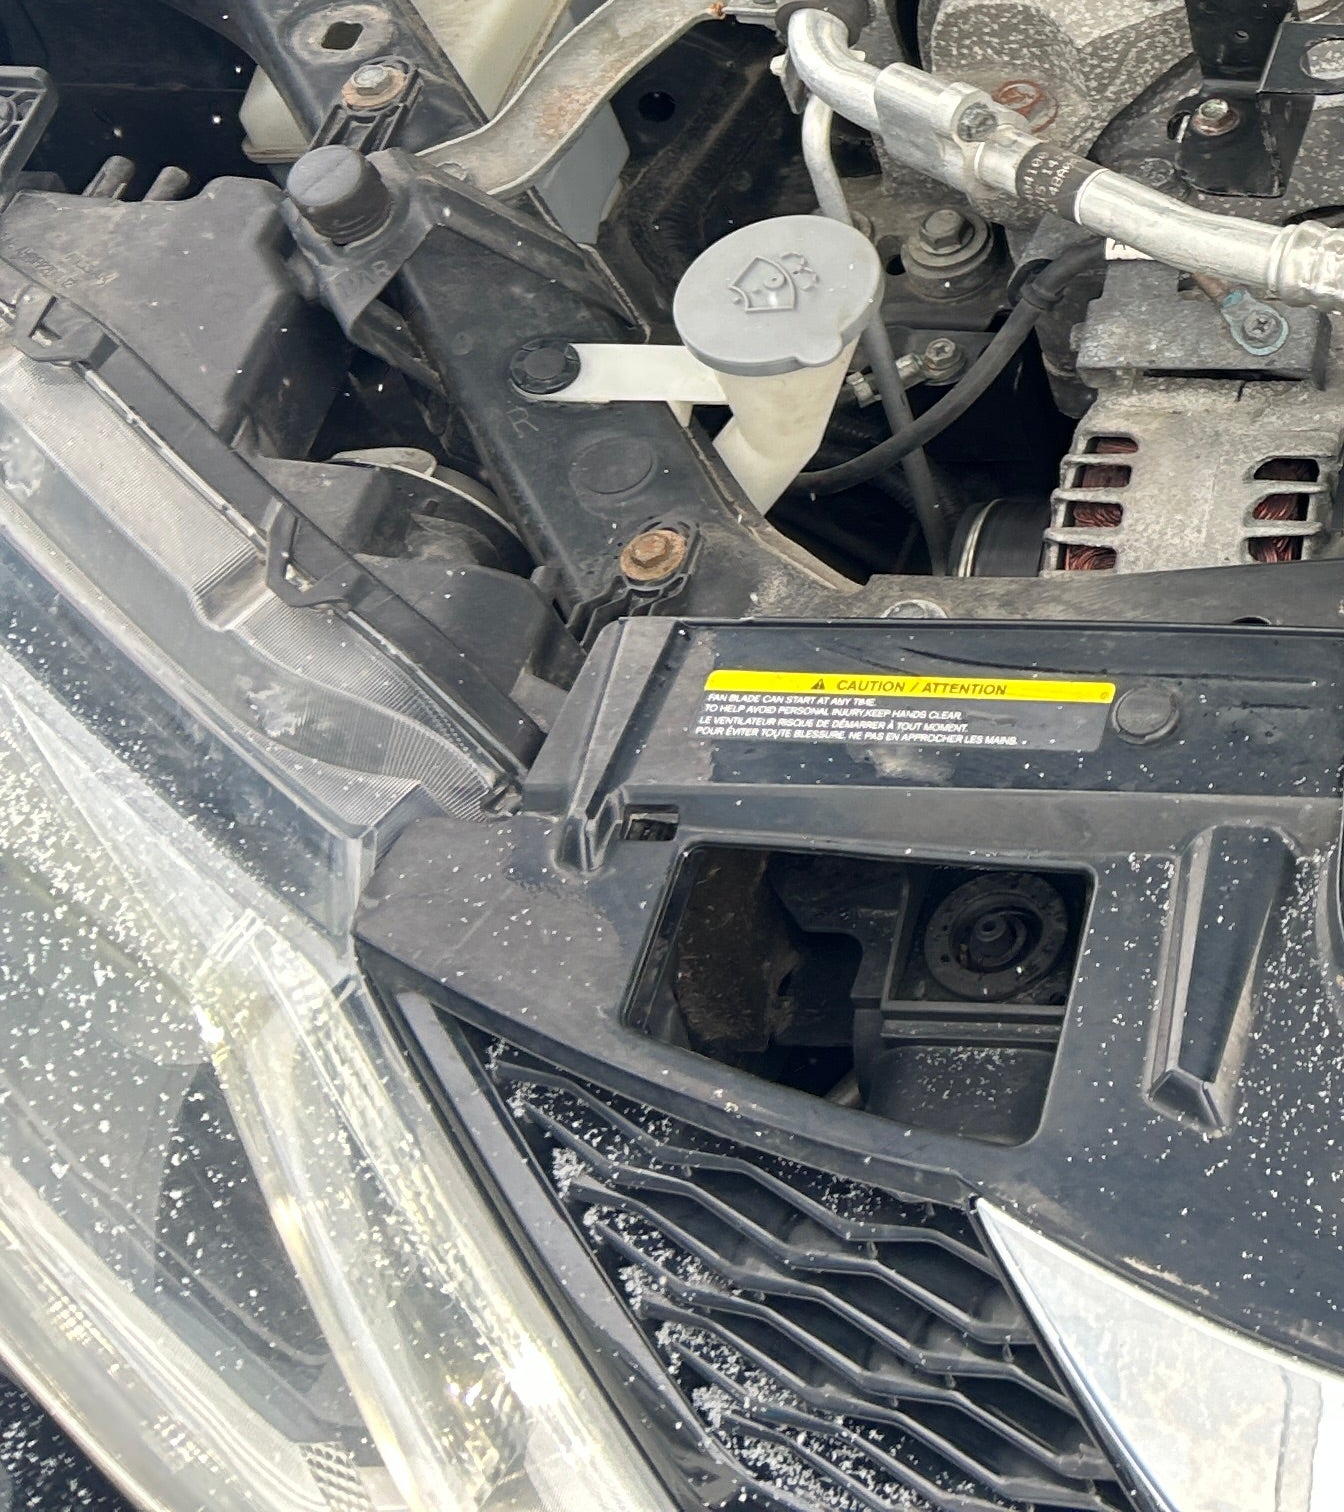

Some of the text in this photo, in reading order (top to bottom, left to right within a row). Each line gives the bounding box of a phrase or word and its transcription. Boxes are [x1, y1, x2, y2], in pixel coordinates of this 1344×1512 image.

[836, 679, 906, 692] CAUTION
[921, 682, 1008, 696] ATTENTION
[707, 693, 728, 702] FAN
[728, 694, 761, 703] BLADE
[762, 695, 784, 704] CAN
[785, 696, 816, 704] START
[817, 697, 829, 705] AT
[829, 697, 852, 706] ANY
[704, 704, 719, 712] TO
[719, 704, 745, 713] HELP
[745, 705, 777, 714] AVOID
[777, 706, 829, 716] PERSONAL
[892, 710, 927, 719] HANDS
[699, 716, 710, 724] LE
[713, 716, 777, 726] VENTILATEUR
[777, 718, 814, 727] RISQUE
[815, 719, 829, 728] DE
[831, 718, 887, 730] DÉMARRER
[896, 722, 923, 731] TOUT
[695, 727, 725, 736] POUR
[725, 725, 759, 736] ÉVITER
[761, 728, 791, 738] TOUTE
[849, 731, 862, 739] NE
[865, 733, 884, 741] PAS
[886, 733, 900, 741] EN
[899, 733, 964, 743] APPROCHER
[964, 735, 983, 744] LES
